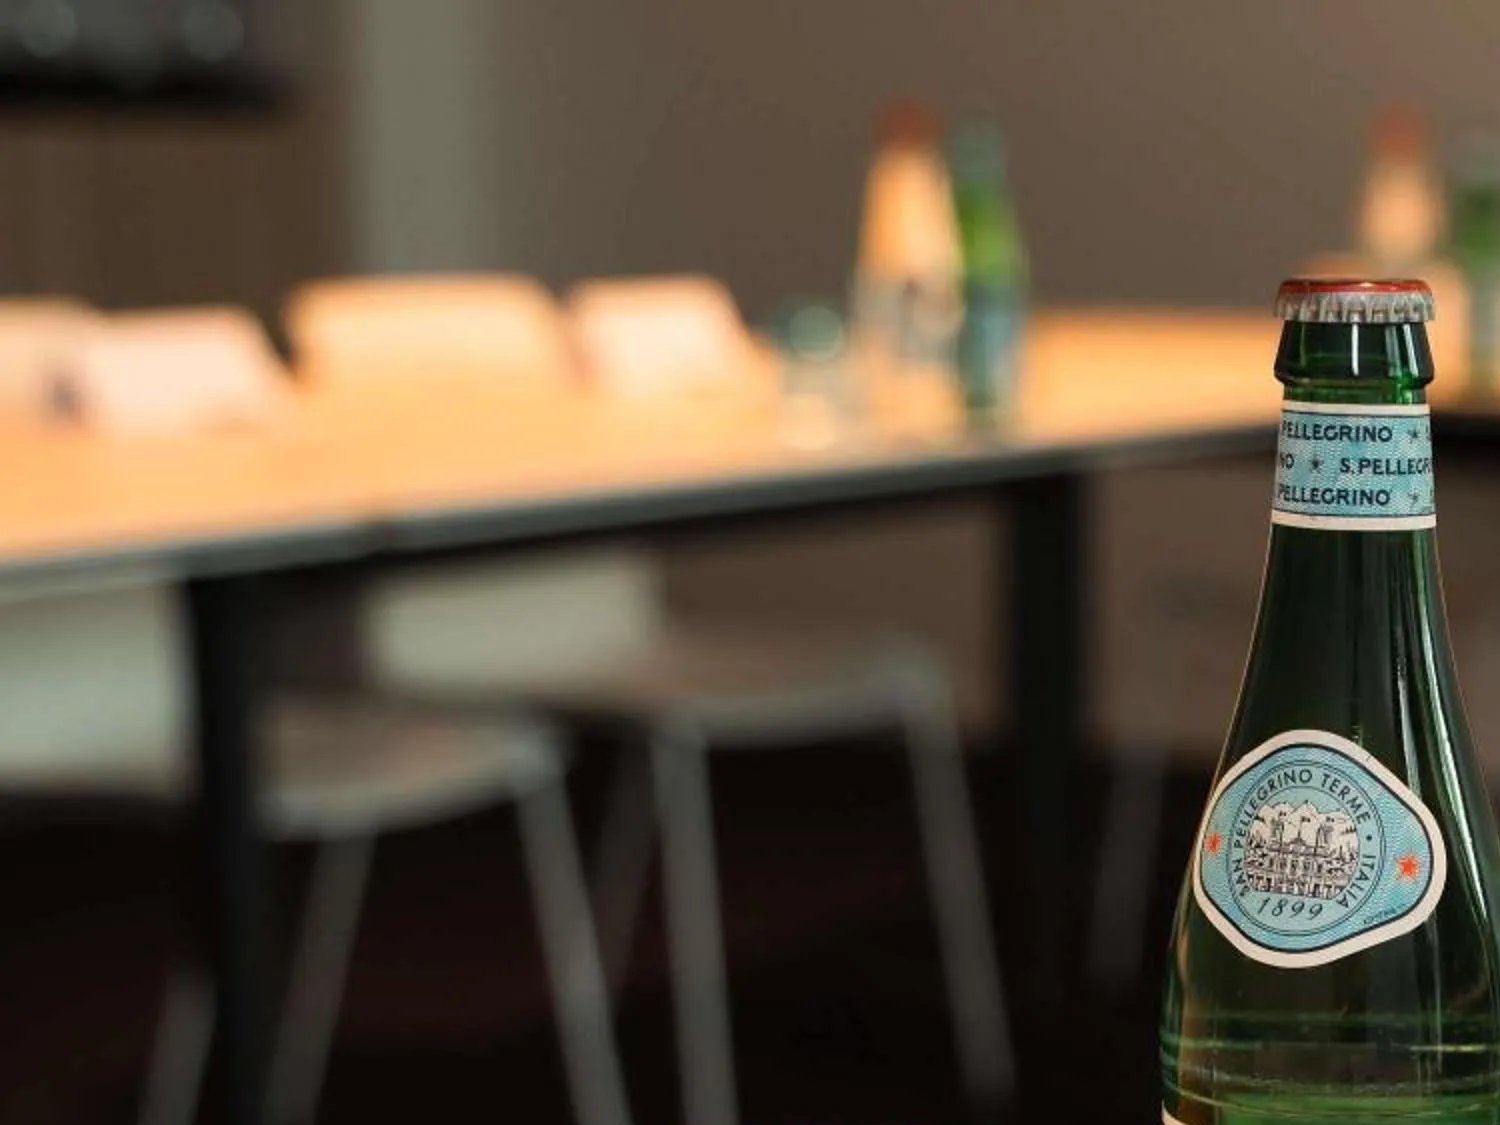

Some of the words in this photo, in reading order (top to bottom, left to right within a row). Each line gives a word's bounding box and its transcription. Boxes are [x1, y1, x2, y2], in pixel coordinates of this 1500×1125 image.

[1282, 419, 1393, 443] PELLEGRINO
[1278, 483, 1391, 506] PELLEGRINO
[1233, 767, 1313, 850] PELLEGRINO
[1320, 773, 1371, 825] TERME
[1335, 854, 1377, 909] ITALIA
[1256, 897, 1324, 921] 1899
